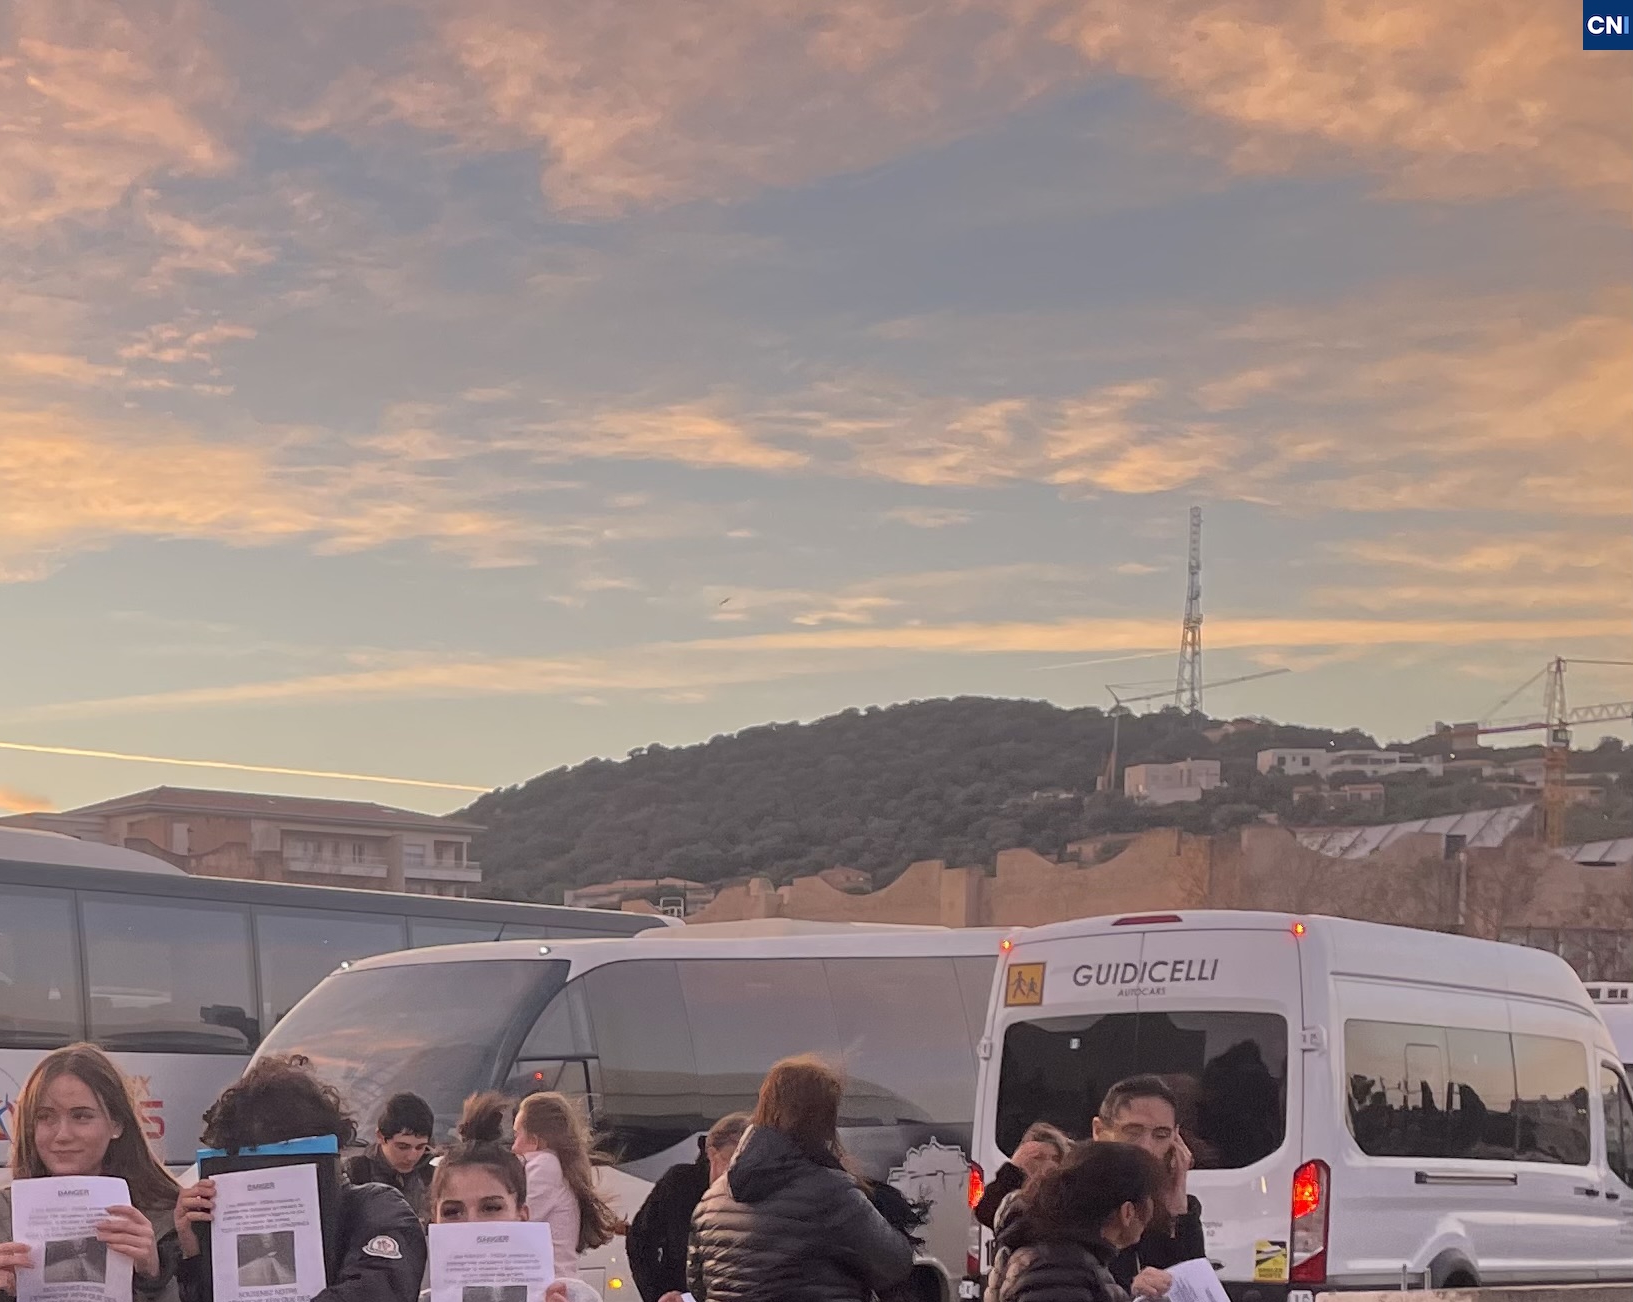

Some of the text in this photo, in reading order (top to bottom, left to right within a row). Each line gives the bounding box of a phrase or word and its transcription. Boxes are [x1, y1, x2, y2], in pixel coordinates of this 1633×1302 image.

[1072, 958, 1219, 987] GUIDICELLI
[1117, 986, 1166, 997] AUTOCARS
[57, 1189, 90, 1198] DANGER
